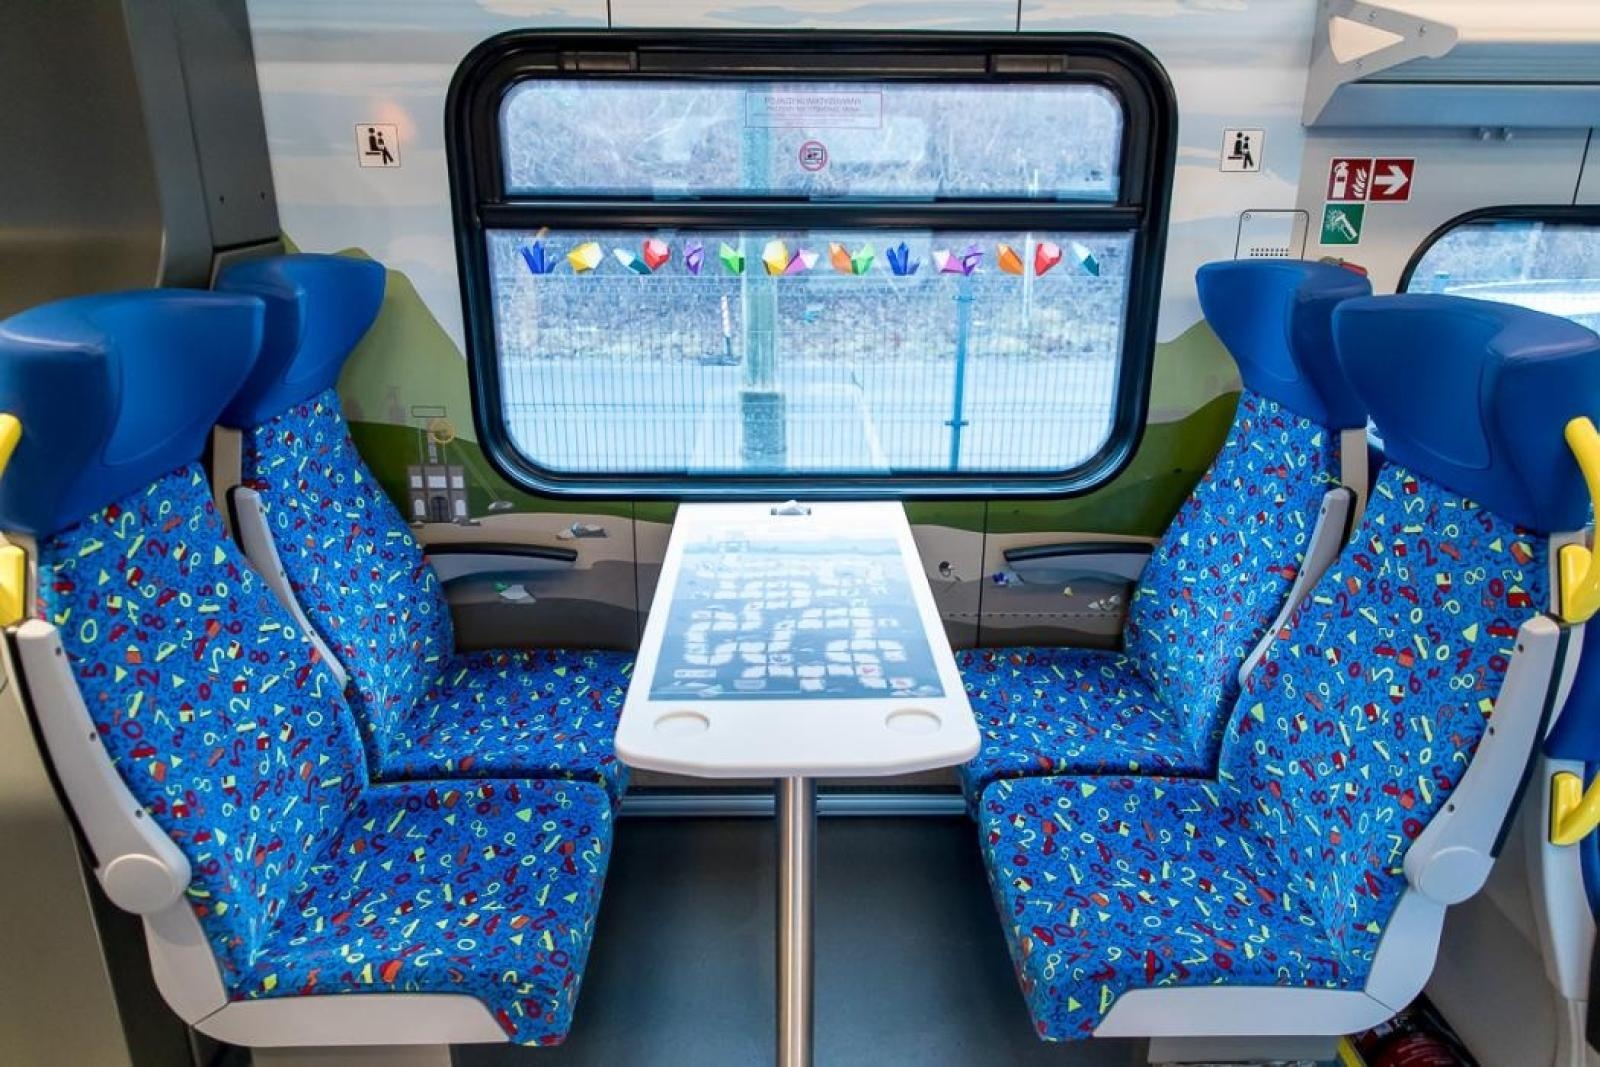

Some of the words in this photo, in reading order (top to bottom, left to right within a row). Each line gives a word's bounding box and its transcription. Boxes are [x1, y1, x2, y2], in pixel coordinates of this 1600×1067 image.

[1417, 538, 1438, 567] 2
[1410, 607, 1423, 624] 0
[80, 619, 98, 643] 0
[1316, 621, 1327, 646] 7
[1436, 644, 1450, 661] 0
[1282, 673, 1296, 699] 8
[1350, 705, 1367, 732] 2
